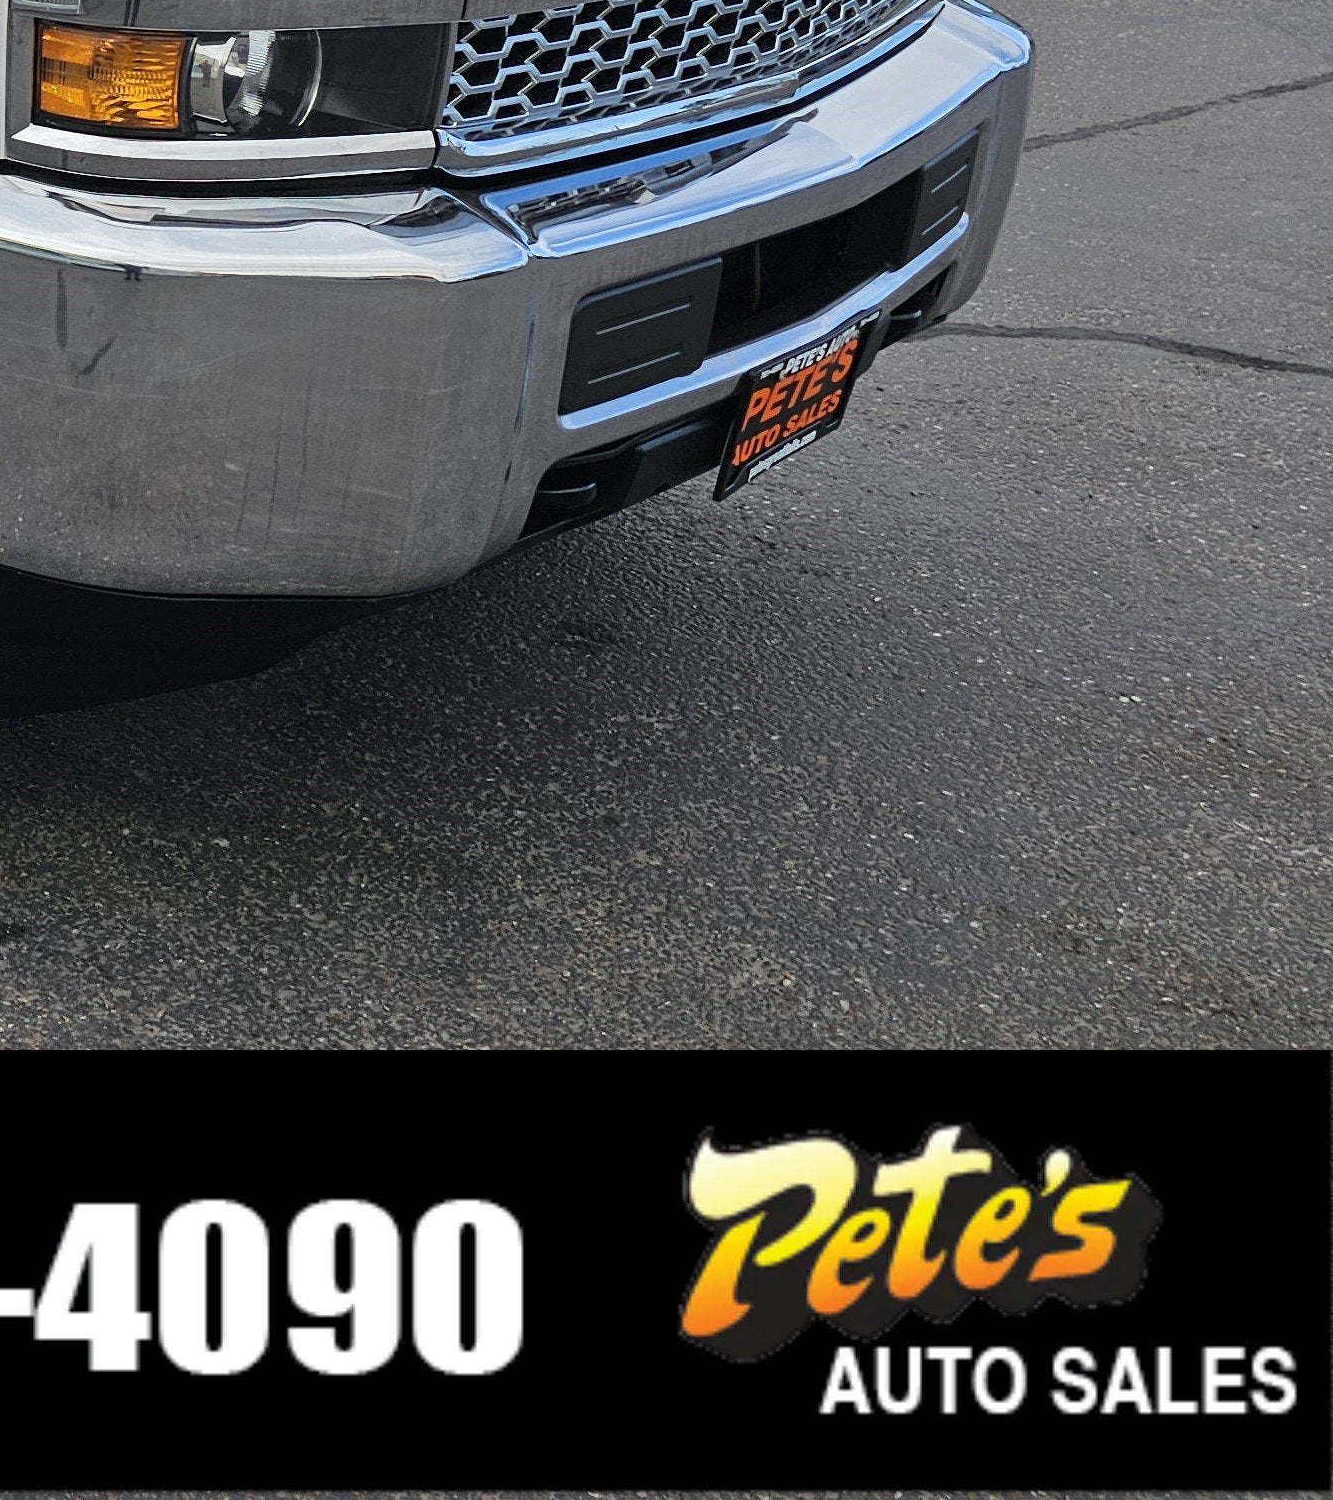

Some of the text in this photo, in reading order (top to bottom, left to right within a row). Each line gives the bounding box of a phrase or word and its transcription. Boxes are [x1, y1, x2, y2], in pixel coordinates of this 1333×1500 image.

[730, 423, 781, 467] AUTO
[783, 389, 842, 438] SALES
[741, 339, 858, 432] PETE'S
